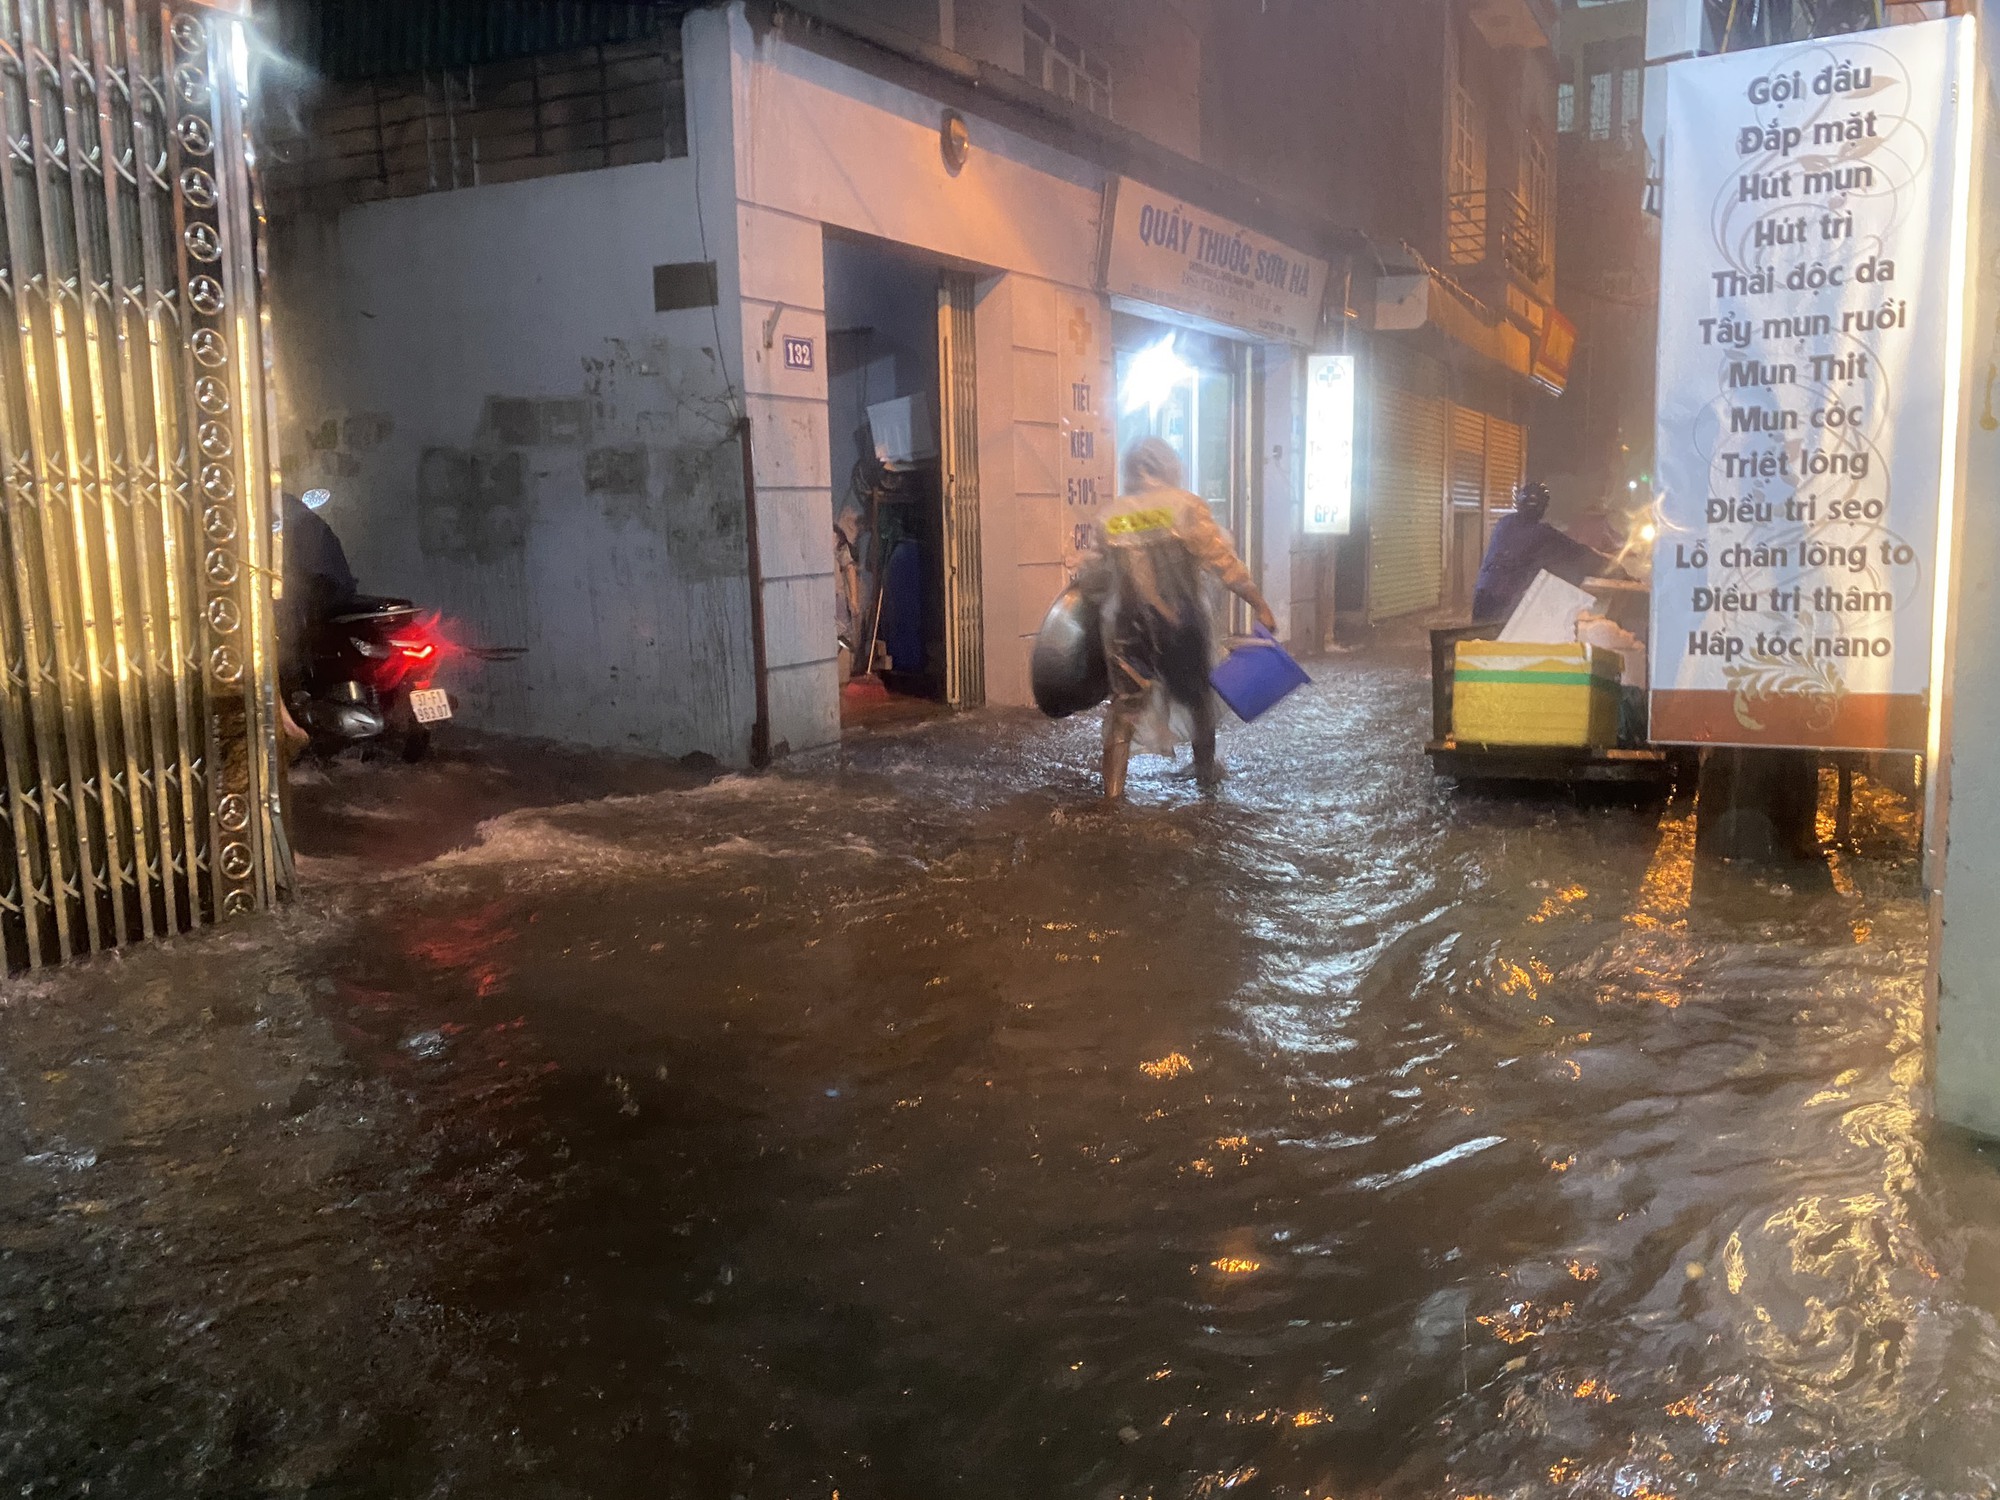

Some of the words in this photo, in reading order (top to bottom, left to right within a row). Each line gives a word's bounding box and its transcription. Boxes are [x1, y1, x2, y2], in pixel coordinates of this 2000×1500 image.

[1747, 71, 1801, 108] Gội
[1813, 60, 1872, 96] đầu
[1739, 118, 1800, 156] Đắp
[1813, 111, 1877, 147] mặt
[1739, 172, 1792, 202] Hút
[1804, 166, 1873, 197] mụn
[1139, 204, 1193, 255] QUẦY
[1197, 229, 1252, 276] THUỐC
[1755, 217, 1807, 248] Hút
[1712, 265, 1774, 298] Thải
[1786, 262, 1843, 296] độc
[1855, 257, 1895, 283] da
[1698, 311, 1751, 348] Tẩy
[1762, 314, 1830, 344] mụn
[1842, 297, 1906, 333] ruồi
[788, 342, 811, 365] 132
[1729, 361, 1796, 392] Mụn
[1810, 352, 1868, 386] Thịt
[1730, 405, 1798, 437] Mụn
[1722, 450, 1789, 483] Triệt
[1801, 448, 1869, 479] lông
[1705, 494, 1773, 524] Điều
[1785, 494, 1816, 527] trị
[1828, 499, 1883, 526] sẹo
[1675, 540, 1708, 569] Lỗ
[1720, 543, 1788, 568] chân
[1798, 542, 1867, 573] lông
[1880, 541, 1915, 566] to
[1691, 585, 1758, 613] Điều
[1769, 585, 1800, 619] trị
[1814, 587, 1893, 612] thâm
[1688, 627, 1744, 662] Hấp
[1756, 631, 1803, 657] tóc
[1814, 635, 1892, 658] nano
